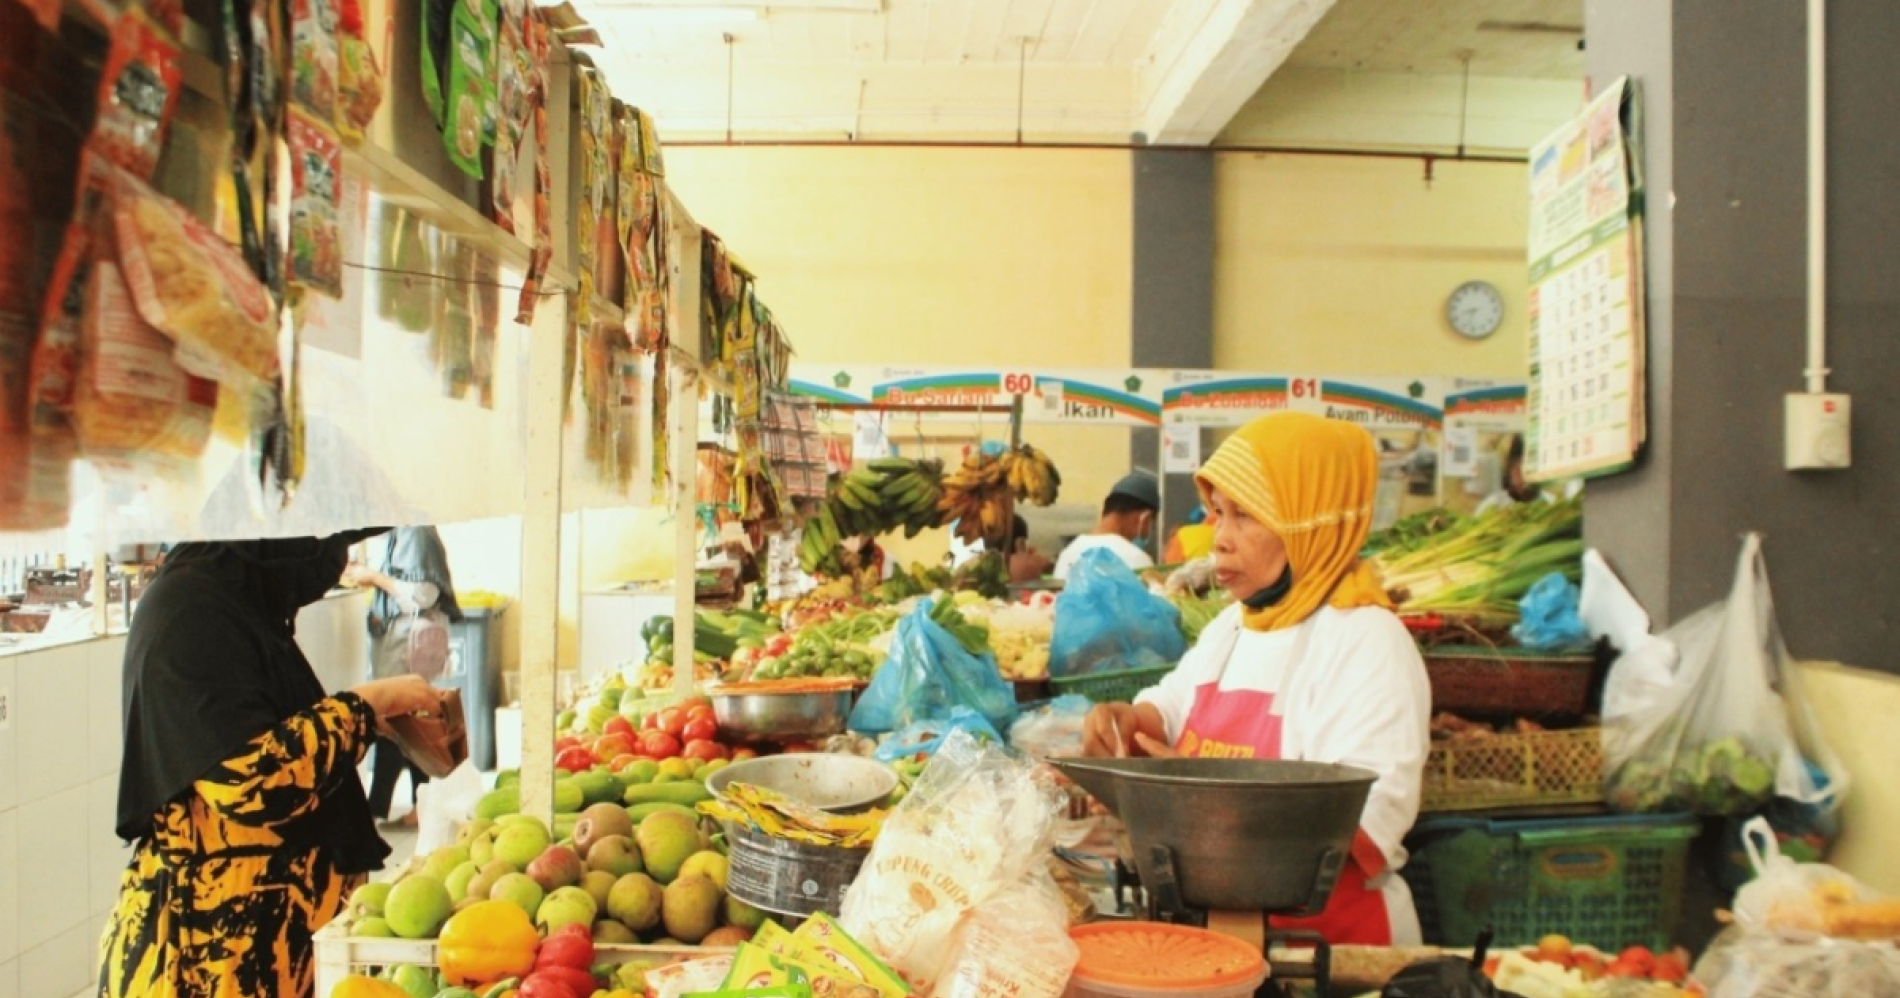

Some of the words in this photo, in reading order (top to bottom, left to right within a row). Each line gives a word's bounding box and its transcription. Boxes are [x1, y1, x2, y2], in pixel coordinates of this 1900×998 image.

[1004, 373, 1032, 393] 60
[1291, 378, 1317, 398] 61
[1064, 400, 1114, 418] Ikan
